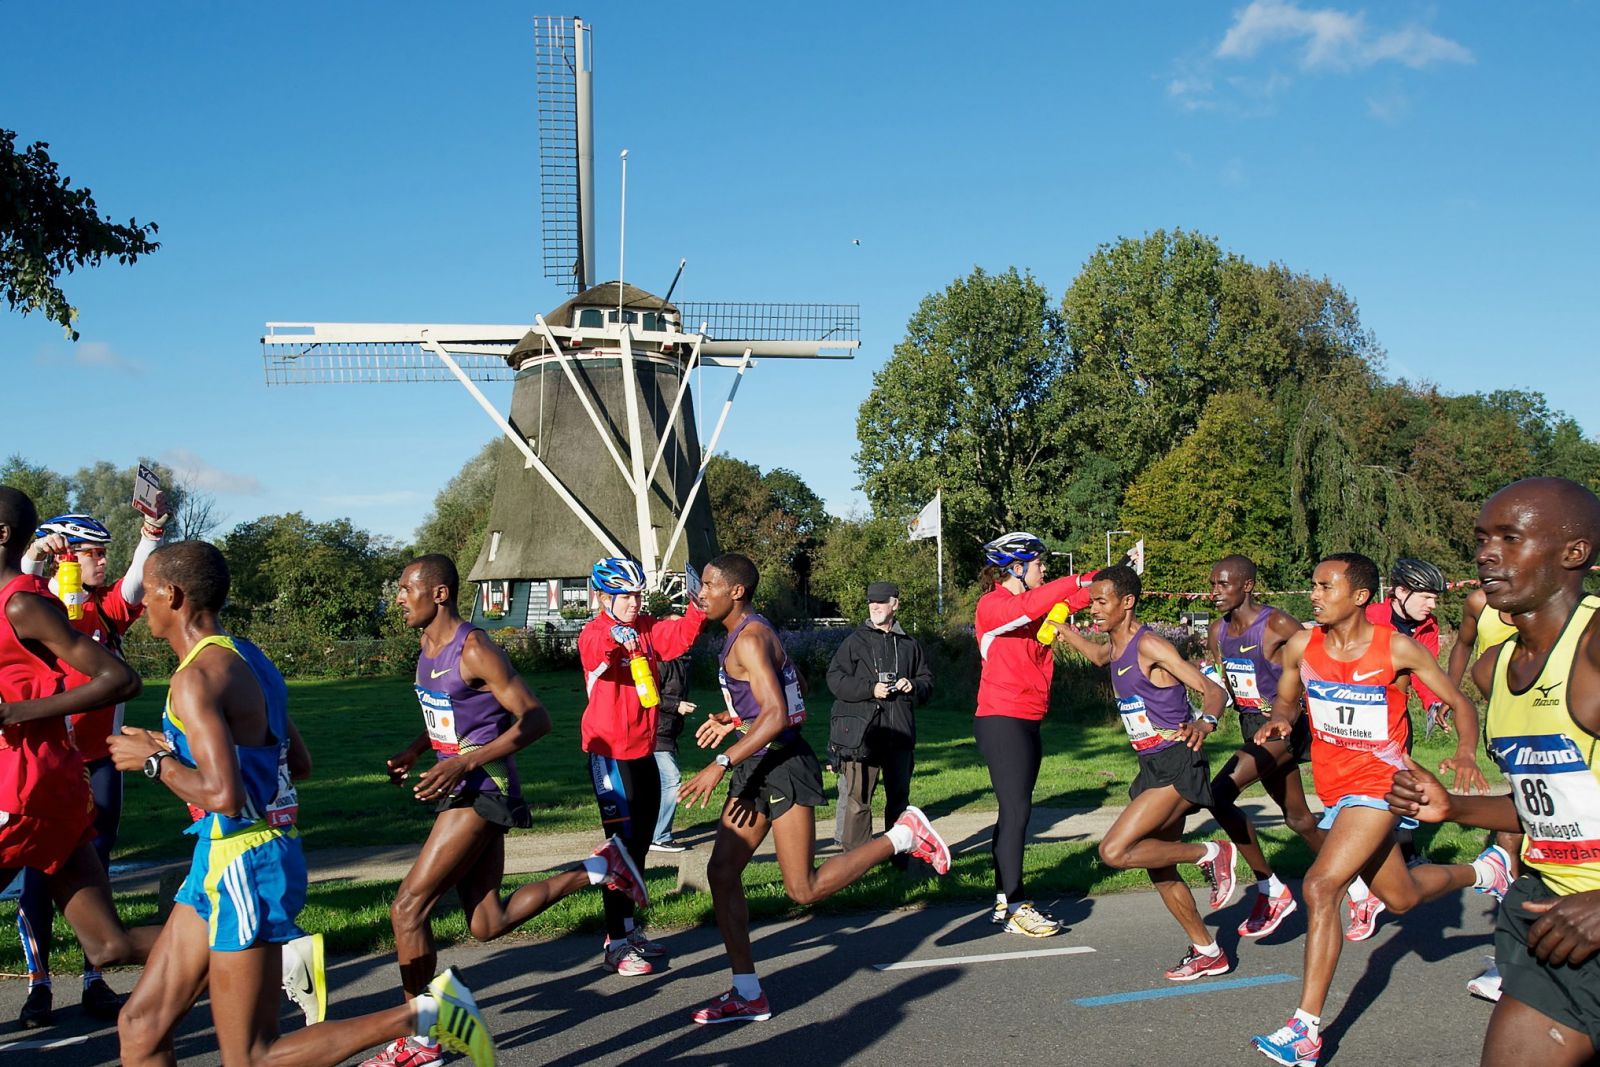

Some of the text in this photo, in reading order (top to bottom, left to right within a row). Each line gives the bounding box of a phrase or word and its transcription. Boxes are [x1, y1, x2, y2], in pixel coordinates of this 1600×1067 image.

[1230, 674, 1238, 688] 3
[425, 709, 436, 729] 10
[1335, 705, 1355, 725] 17
[1349, 727, 1372, 738] Feleke
[1520, 778, 1555, 816] 86
